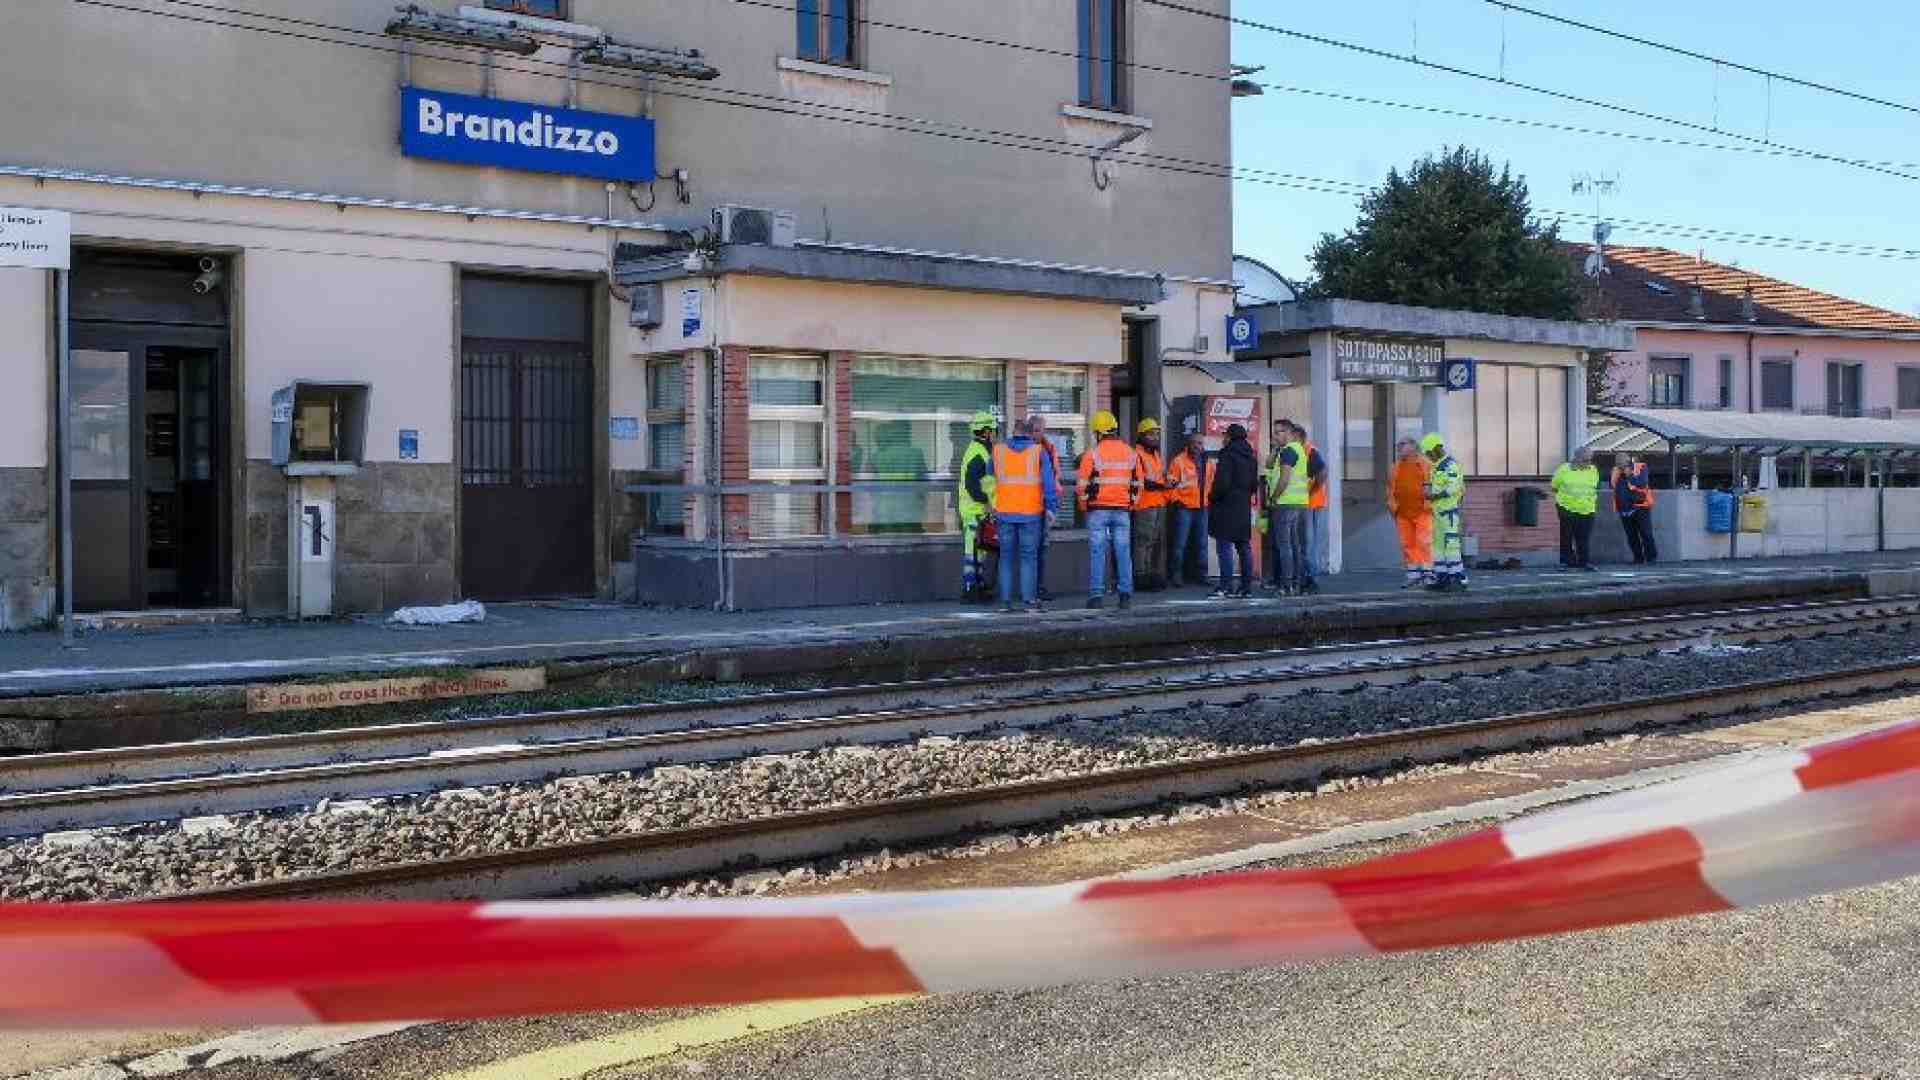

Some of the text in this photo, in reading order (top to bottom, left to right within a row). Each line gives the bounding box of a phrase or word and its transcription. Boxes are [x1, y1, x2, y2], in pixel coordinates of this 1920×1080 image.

[419, 98, 619, 156] Brandizzo
[280, 677, 508, 705] Do not cross the railway lines
